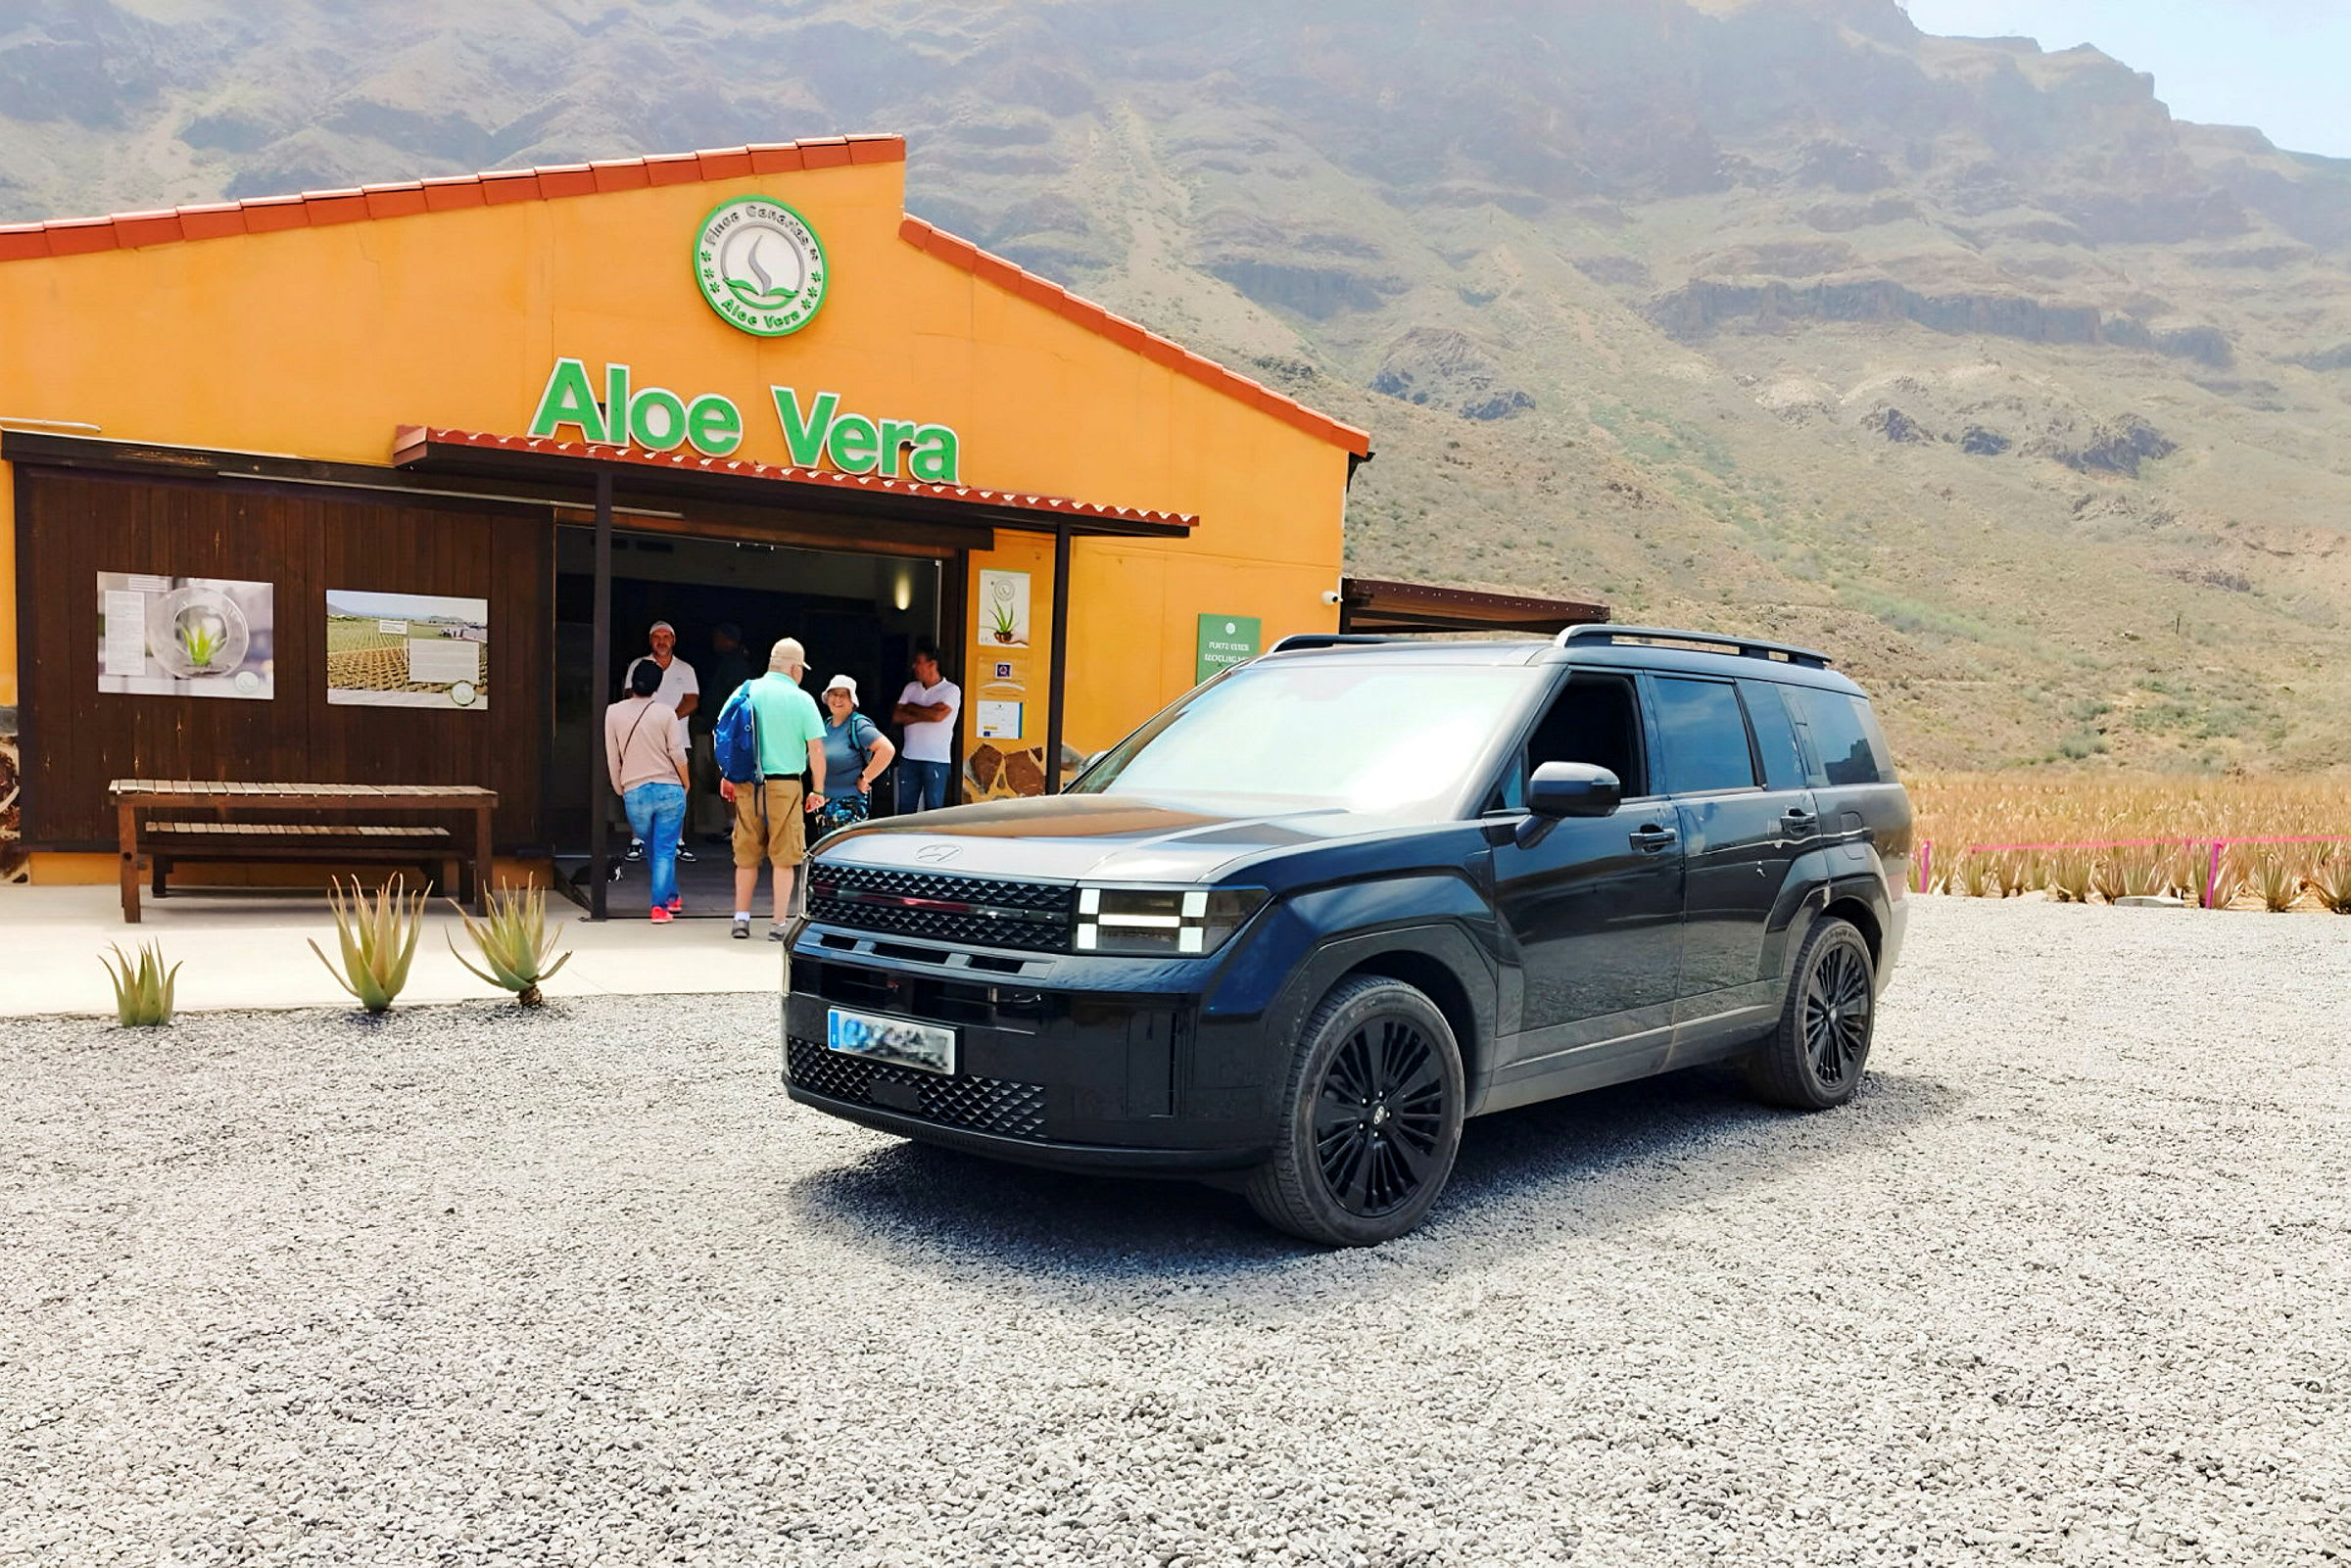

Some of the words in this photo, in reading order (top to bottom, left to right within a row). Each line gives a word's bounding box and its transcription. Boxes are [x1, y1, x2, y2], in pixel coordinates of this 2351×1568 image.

[704, 212, 741, 247] Finca
[721, 299, 758, 326] Aloe
[763, 309, 801, 329] Vera
[527, 356, 744, 458] Aloe
[770, 385, 961, 486] Vera
